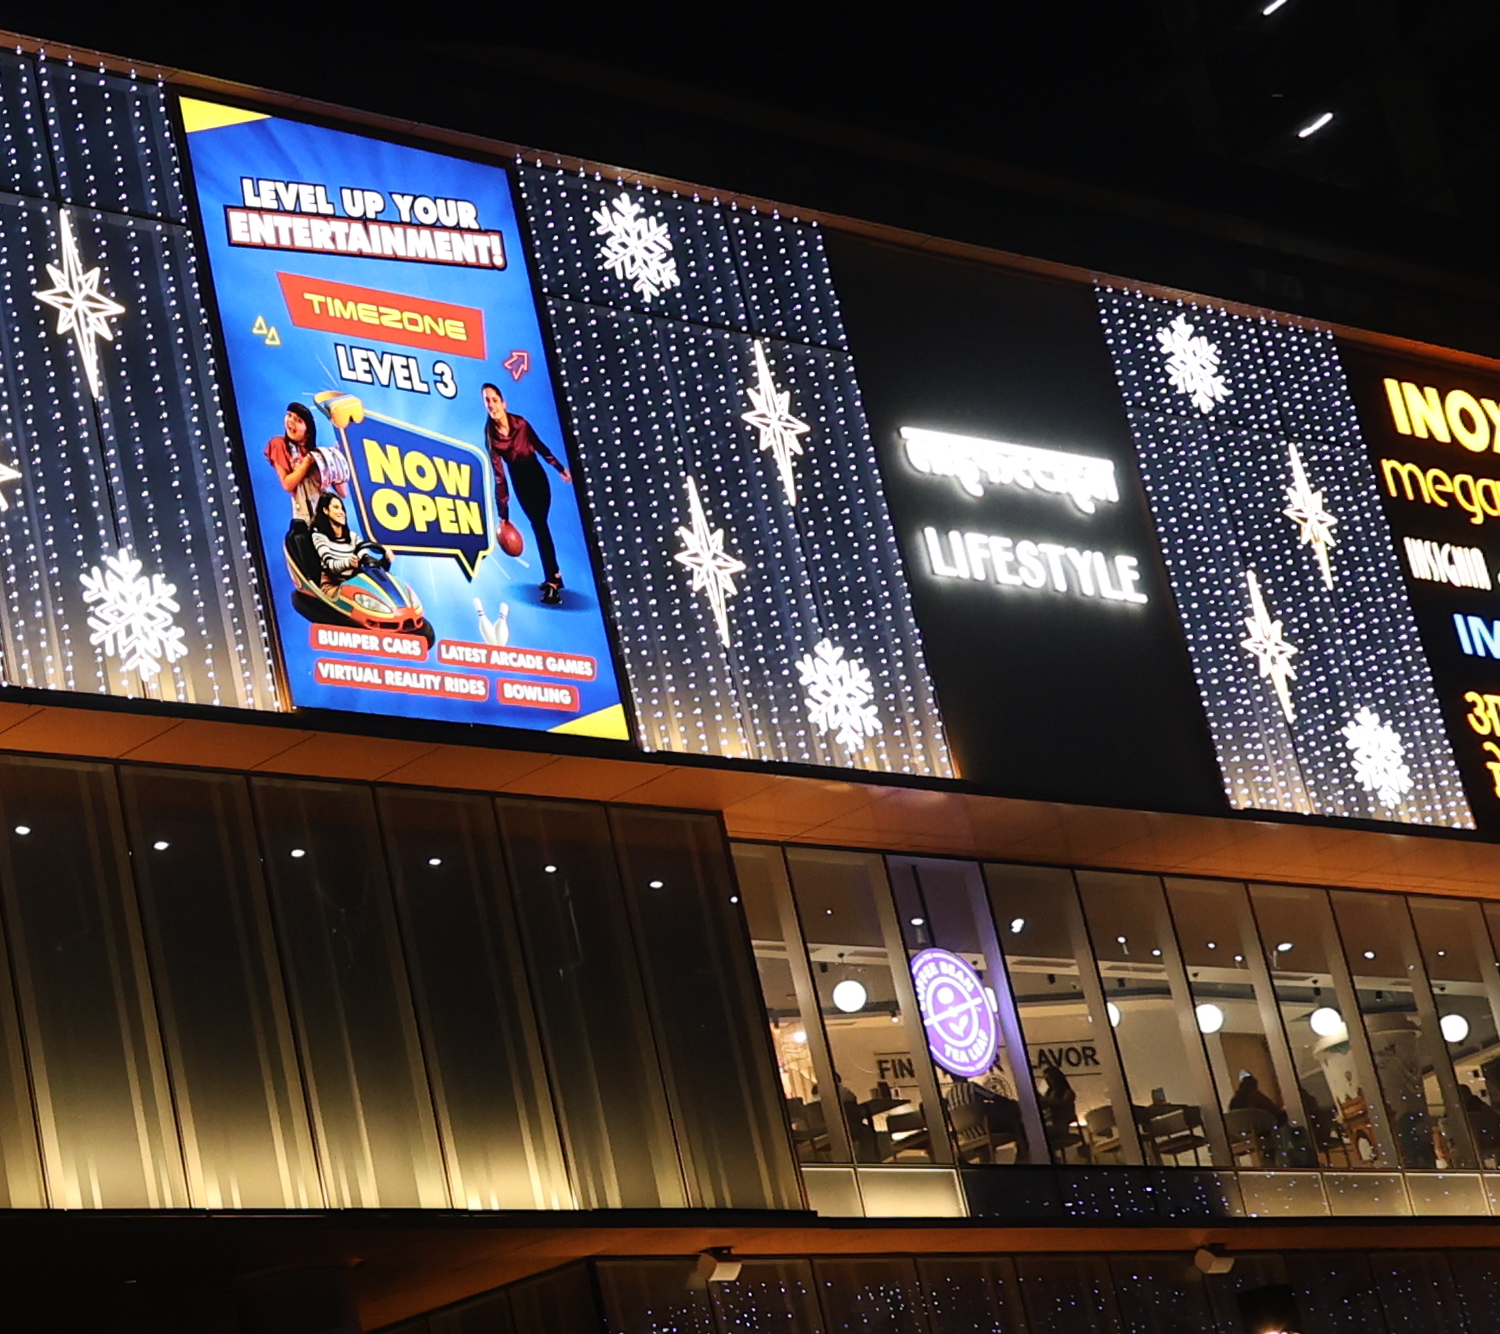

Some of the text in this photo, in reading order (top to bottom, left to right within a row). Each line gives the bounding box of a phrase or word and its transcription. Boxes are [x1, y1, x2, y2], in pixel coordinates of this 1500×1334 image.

[241, 178, 480, 230] LEVEL UP YOUR
[228, 210, 504, 267] ENTERTAINMENT!
[303, 292, 468, 341] TIMEZONE
[335, 344, 457, 399] LEVEL 3
[362, 438, 471, 498] NOW
[371, 488, 484, 535] OPEN
[924, 527, 1148, 604] LIFESTYLE
[318, 630, 421, 656] BUMPER CARS
[441, 644, 593, 676] LATEST ARCADE GAMES
[318, 662, 486, 695] VIRTUAL REALITY RIDES
[503, 683, 571, 704] BOWLING
[939, 961, 975, 992] BEAN
[944, 1043, 970, 1063] TEA
[968, 1029, 988, 1061] LEAF
